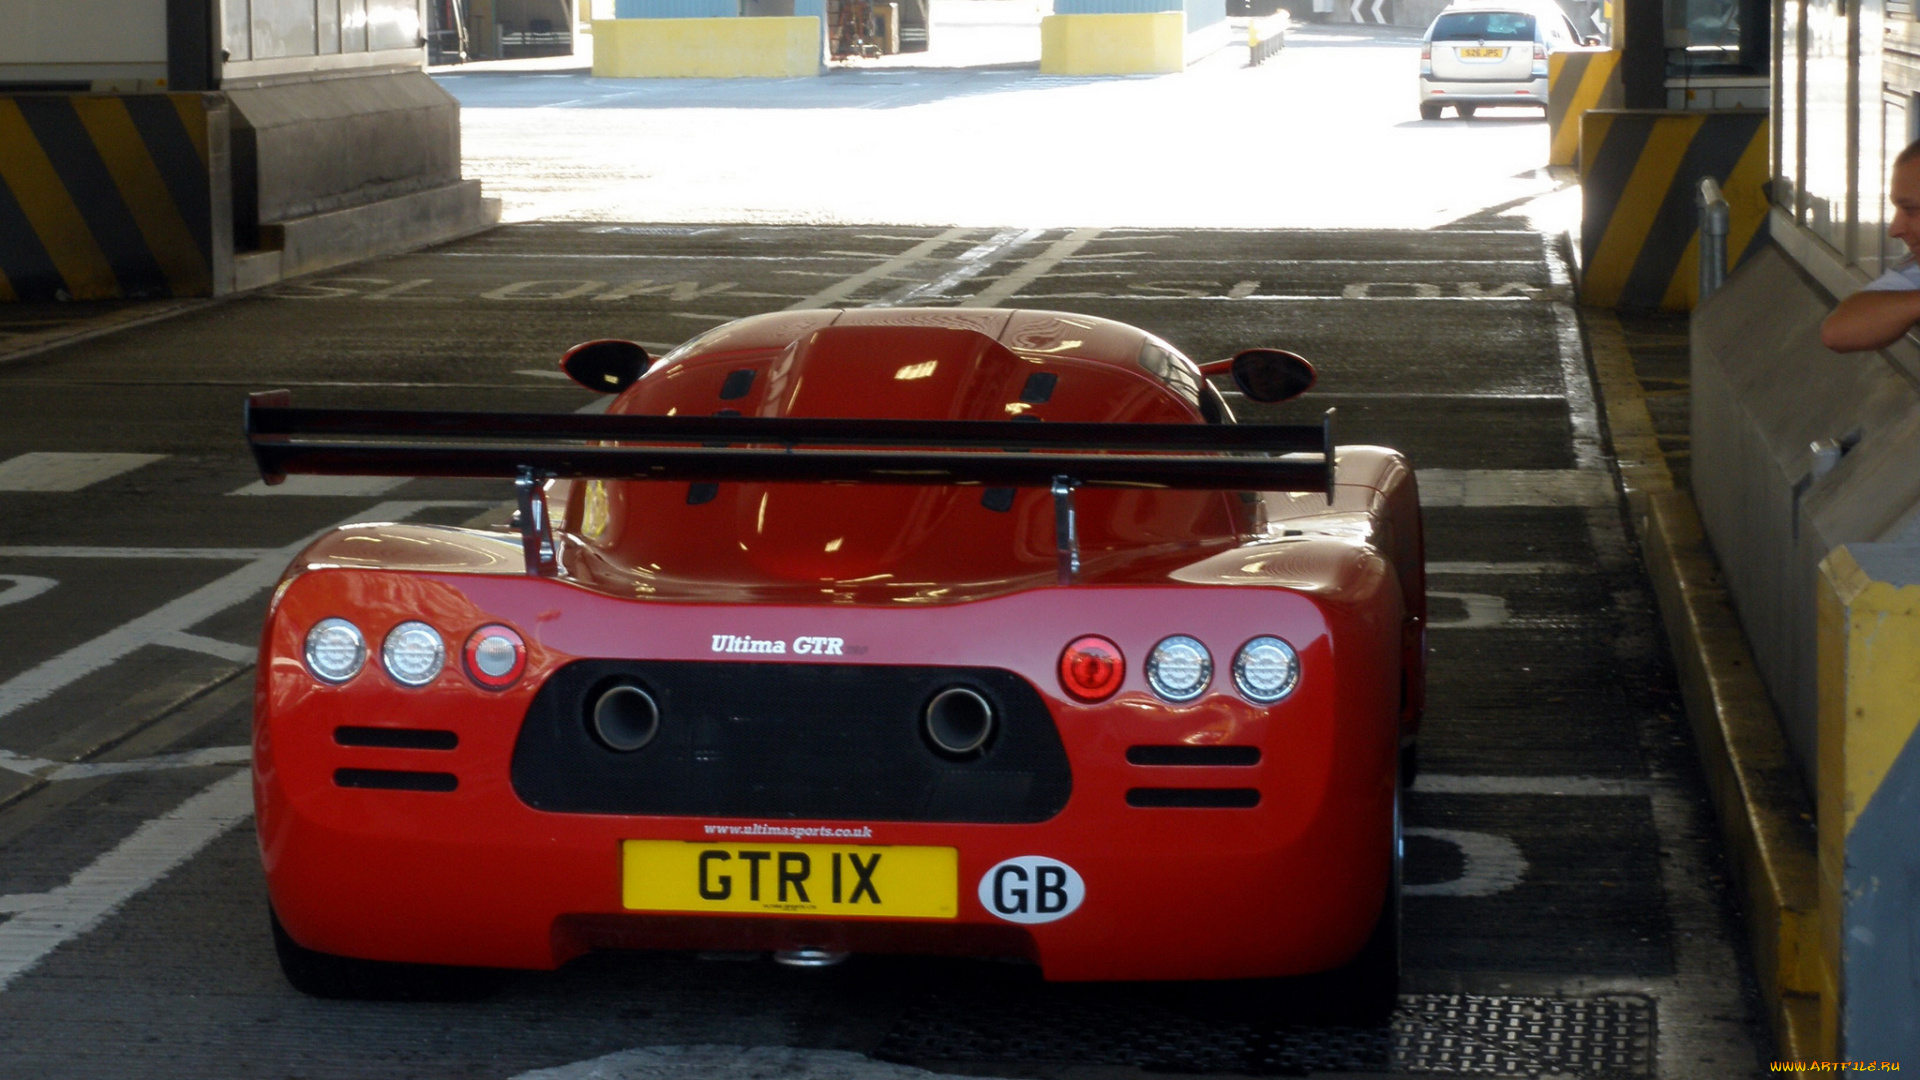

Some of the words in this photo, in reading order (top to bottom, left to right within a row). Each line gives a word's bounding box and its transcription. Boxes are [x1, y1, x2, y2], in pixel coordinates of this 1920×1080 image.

[711, 634, 786, 654] Ultima
[792, 636, 844, 655] GTR
[704, 823, 872, 839] www.ultimasports.co.uk
[698, 850, 811, 903] GTR
[993, 864, 1068, 915] GB
